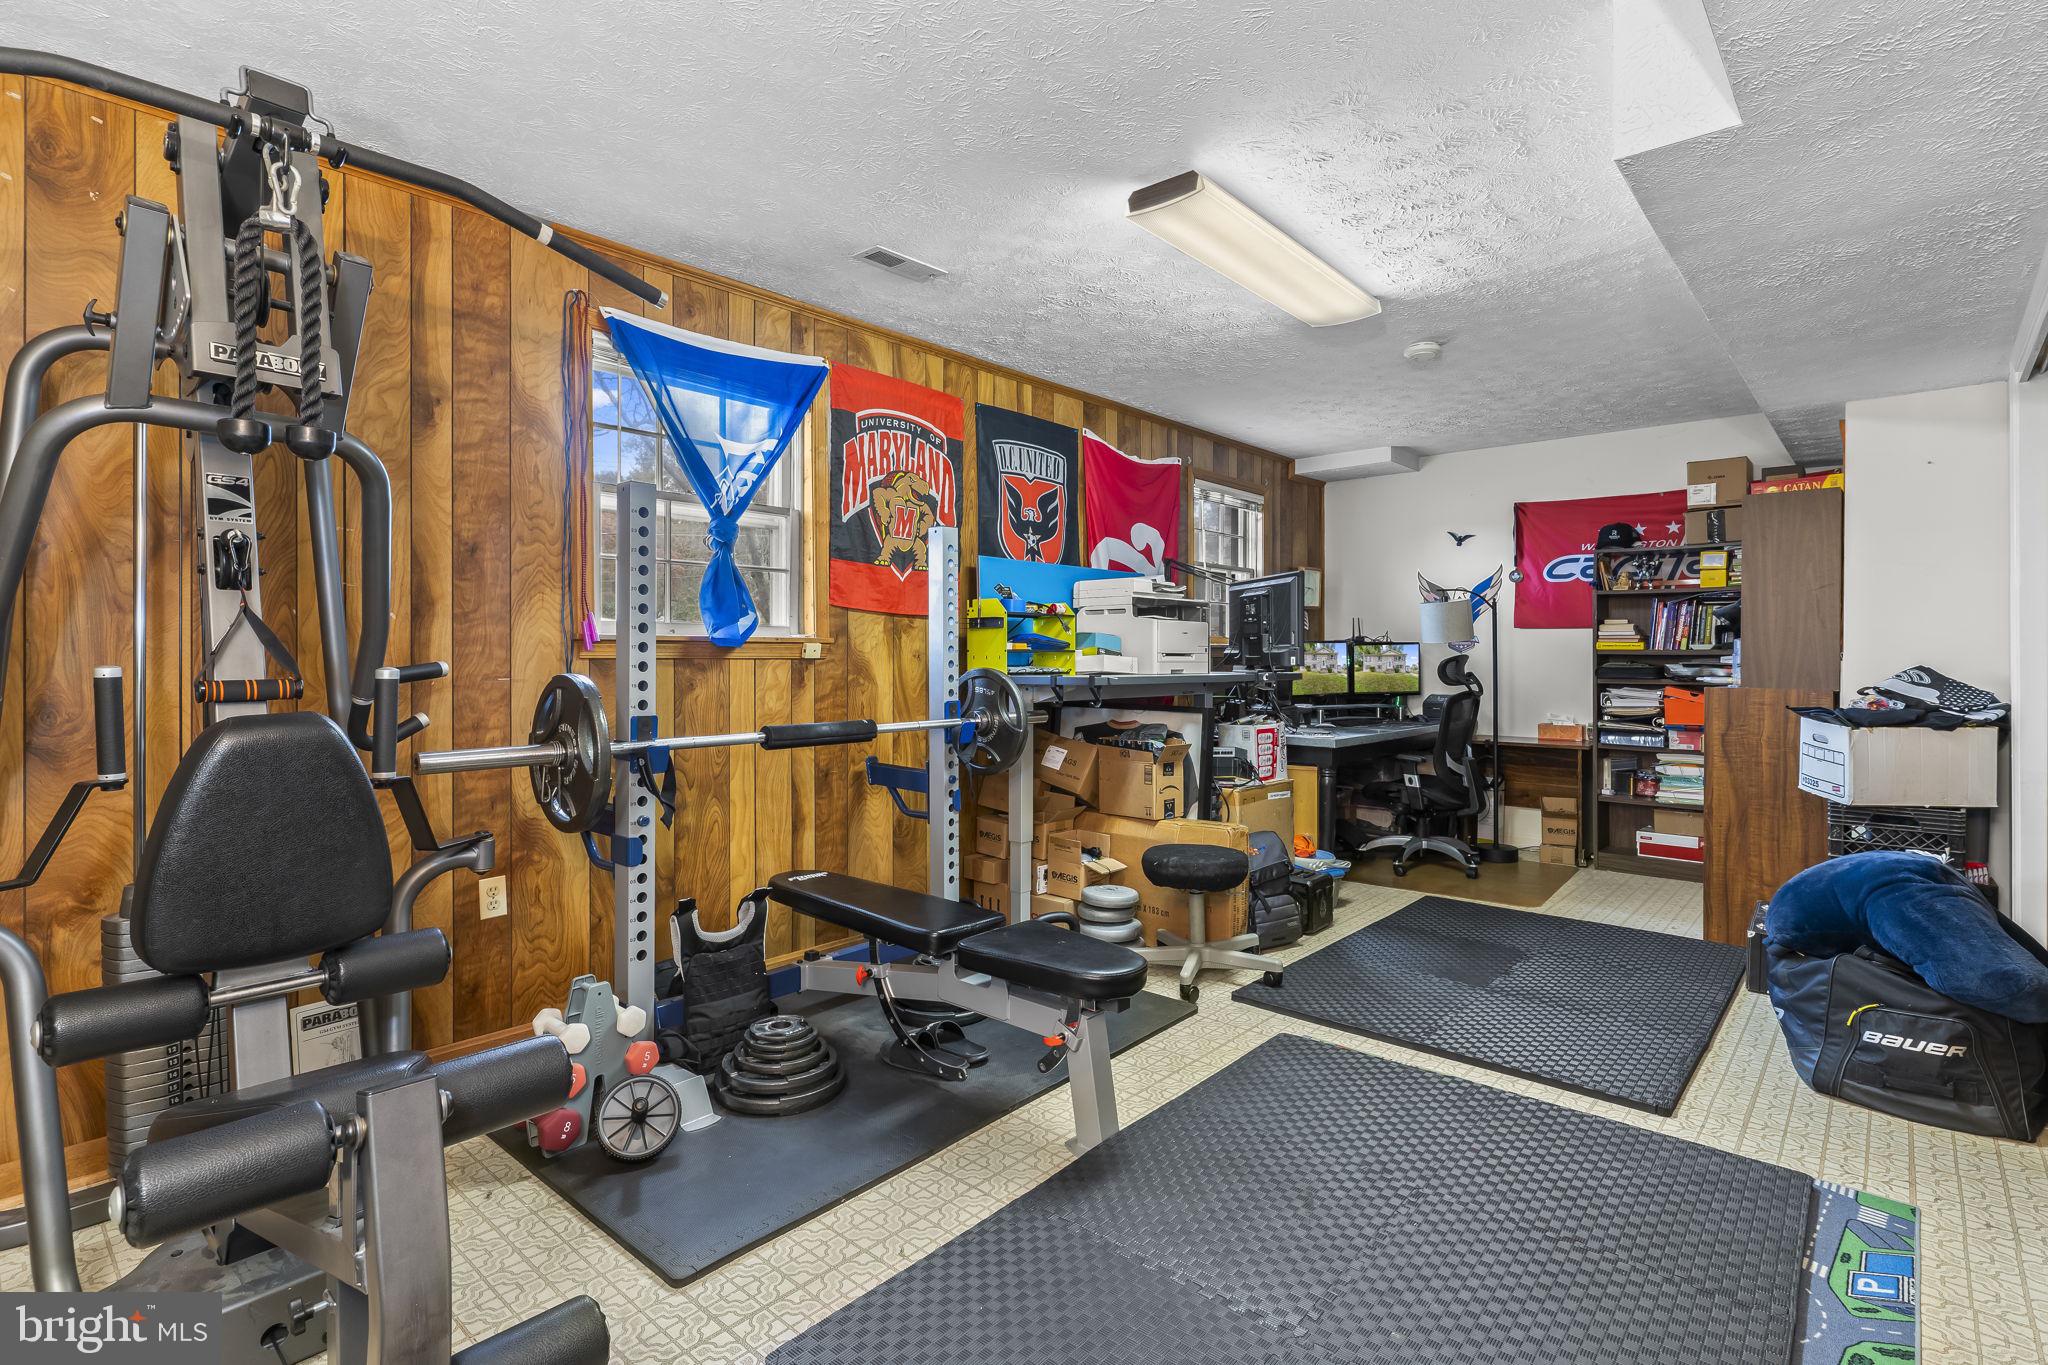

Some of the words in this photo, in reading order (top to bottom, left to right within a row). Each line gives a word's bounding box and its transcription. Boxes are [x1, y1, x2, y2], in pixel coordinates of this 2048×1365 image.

[860, 418, 922, 435] UNIVERSITY
[930, 435, 942, 446] OF
[207, 475, 249, 486] GS4
[841, 429, 956, 528] MARYLAND
[1783, 481, 1821, 492] CATAN
[892, 504, 918, 540] M
[1057, 872, 1078, 883] AEGIS
[1862, 1030, 1967, 1058] BAUER
[644, 1051, 651, 1061] 5
[563, 1121, 571, 1132] 8
[1857, 1277, 1895, 1294] P
